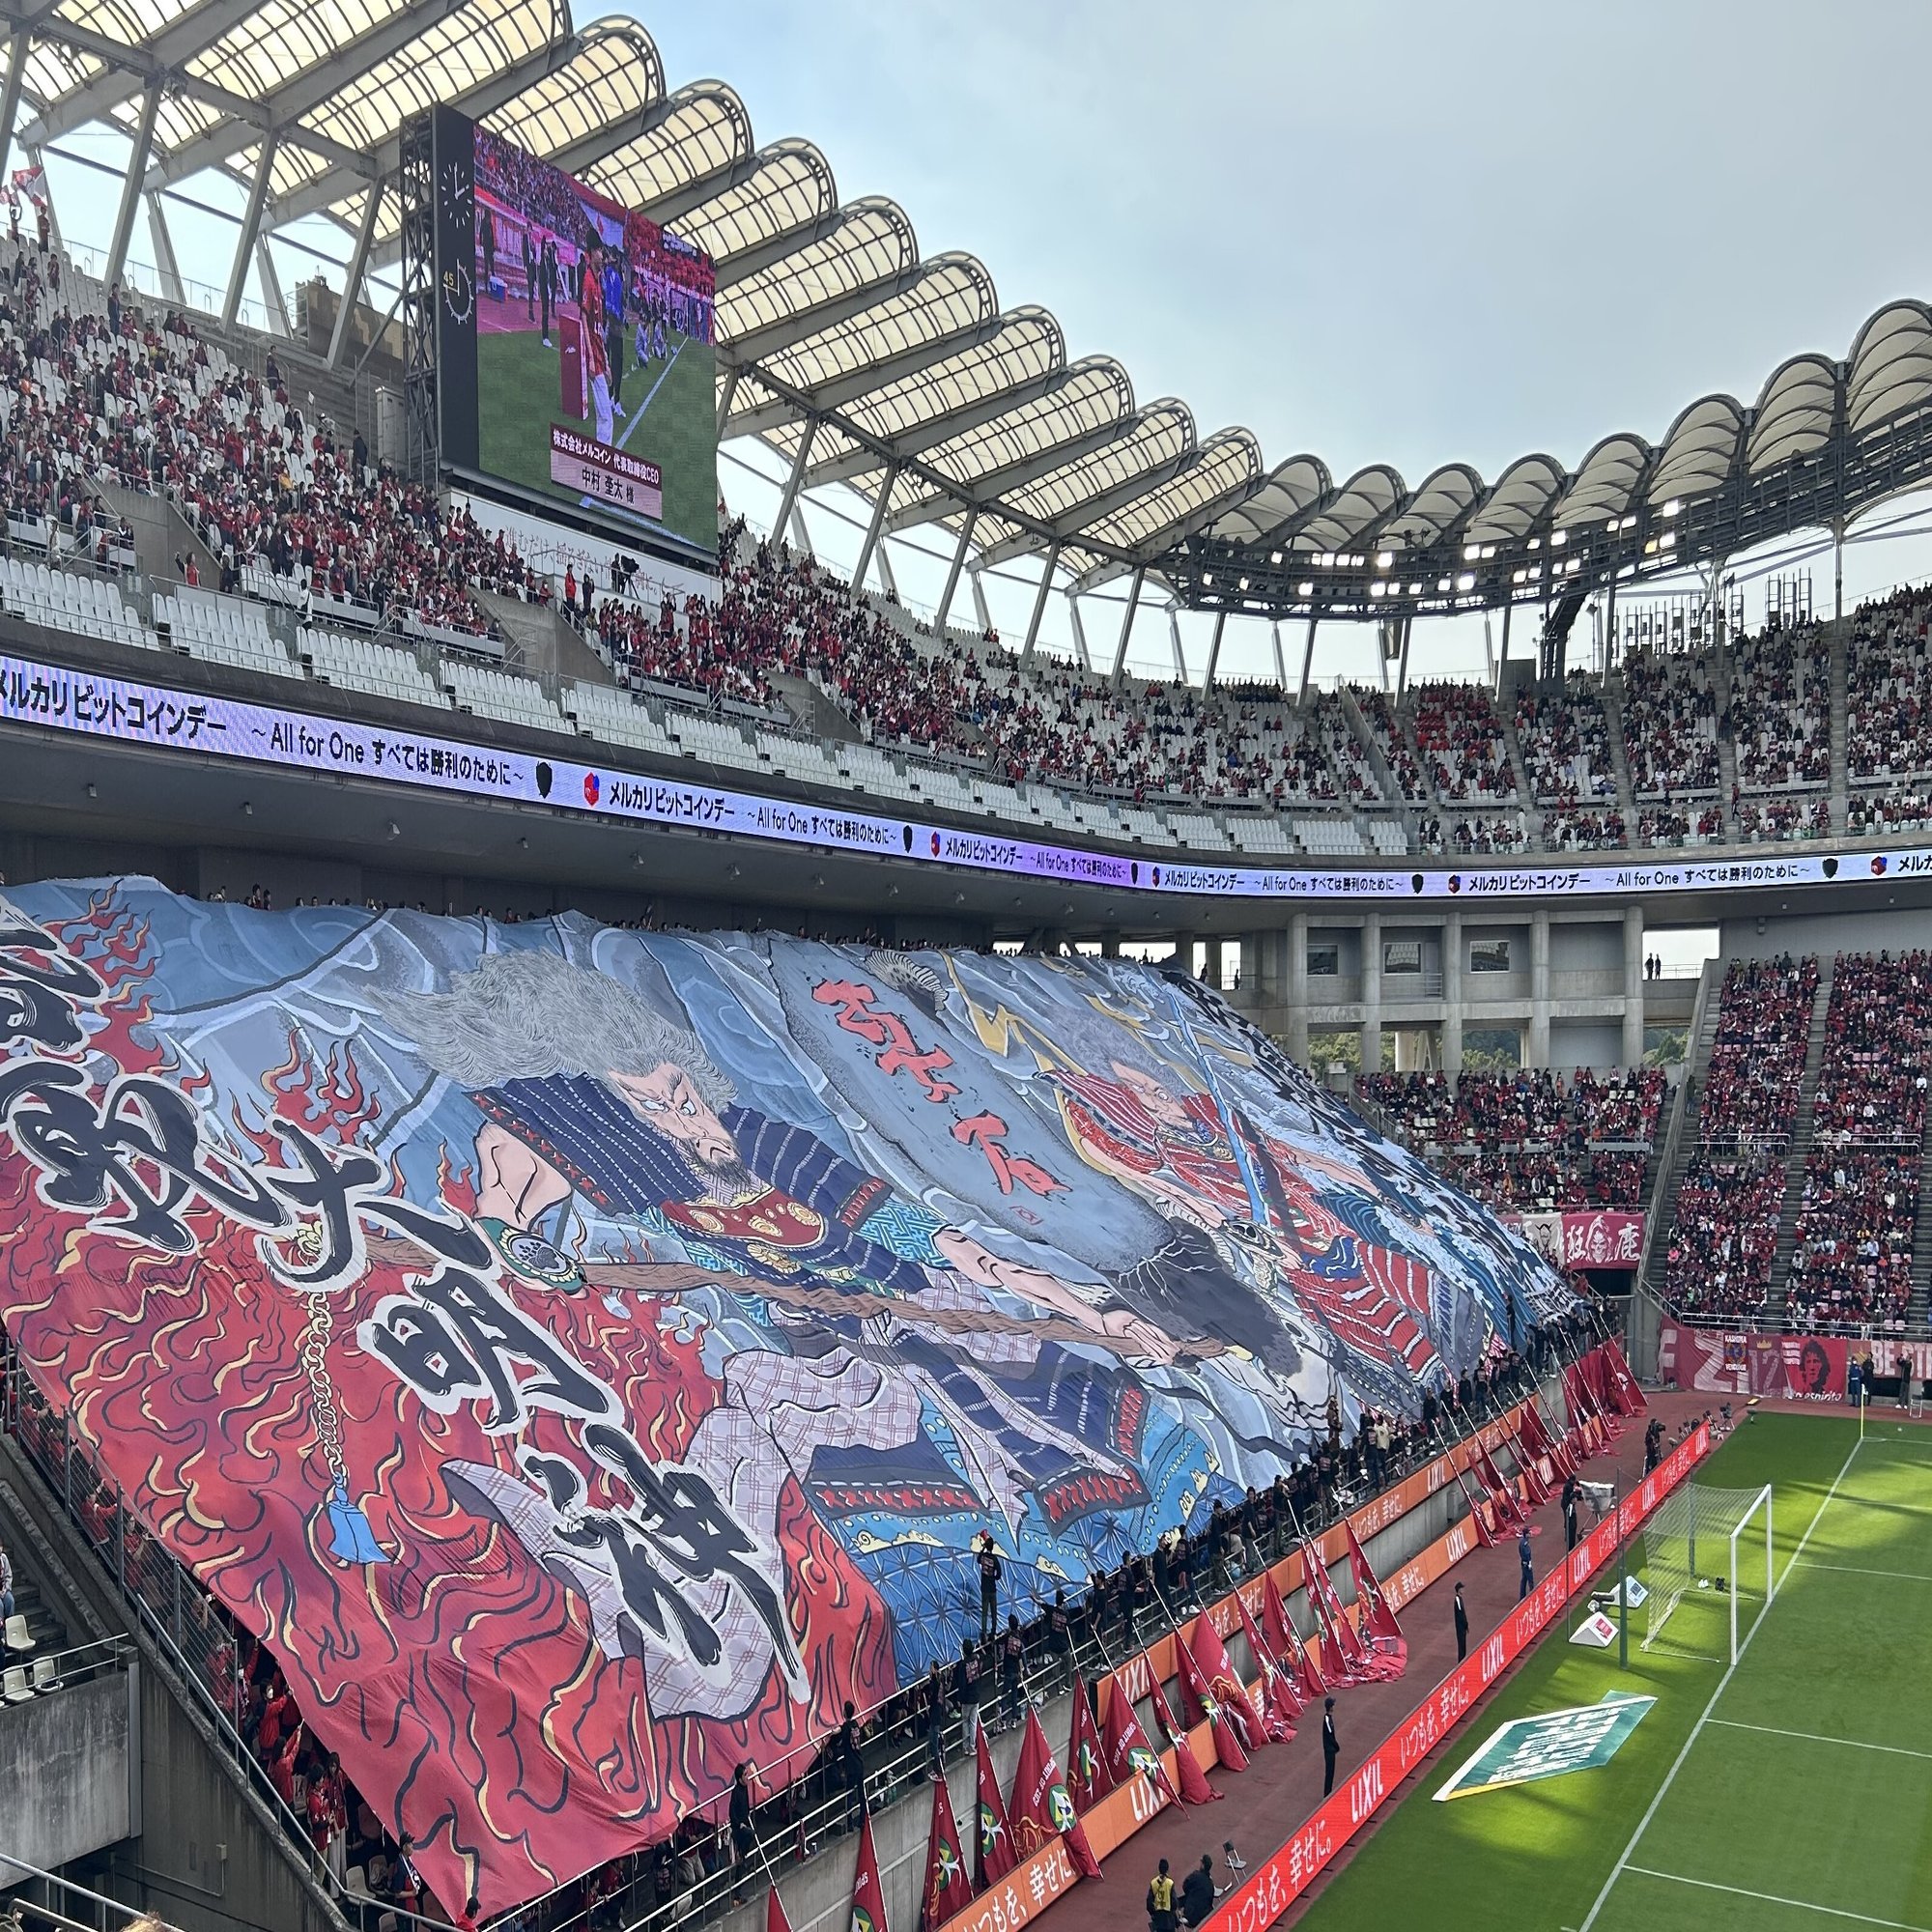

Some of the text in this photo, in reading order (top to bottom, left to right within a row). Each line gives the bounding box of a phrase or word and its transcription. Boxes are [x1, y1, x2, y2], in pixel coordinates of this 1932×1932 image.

[443, 270, 454, 286] 45
[553, 429, 611, 465] 株式会社メルコイン
[582, 466, 600, 493] 中村
[298, 730, 325, 757] for
[329, 731, 364, 764] One
[772, 810, 785, 831] for
[788, 810, 808, 833] One
[1274, 876, 1287, 891] for
[1289, 876, 1307, 891] One
[1634, 871, 1651, 886] for
[1654, 871, 1679, 886] One
[1871, 1340, 1895, 1376] BE
[1428, 1460, 1445, 1493] LIXIL
[1446, 1527, 1467, 1562] LIXIL
[1574, 1545, 1591, 1584] LIXIL
[1482, 1634, 1505, 1683] LIXIL
[1400, 1674, 1469, 1769] いつもを、幸せに。
[1350, 1759, 1383, 1823] LIXIL
